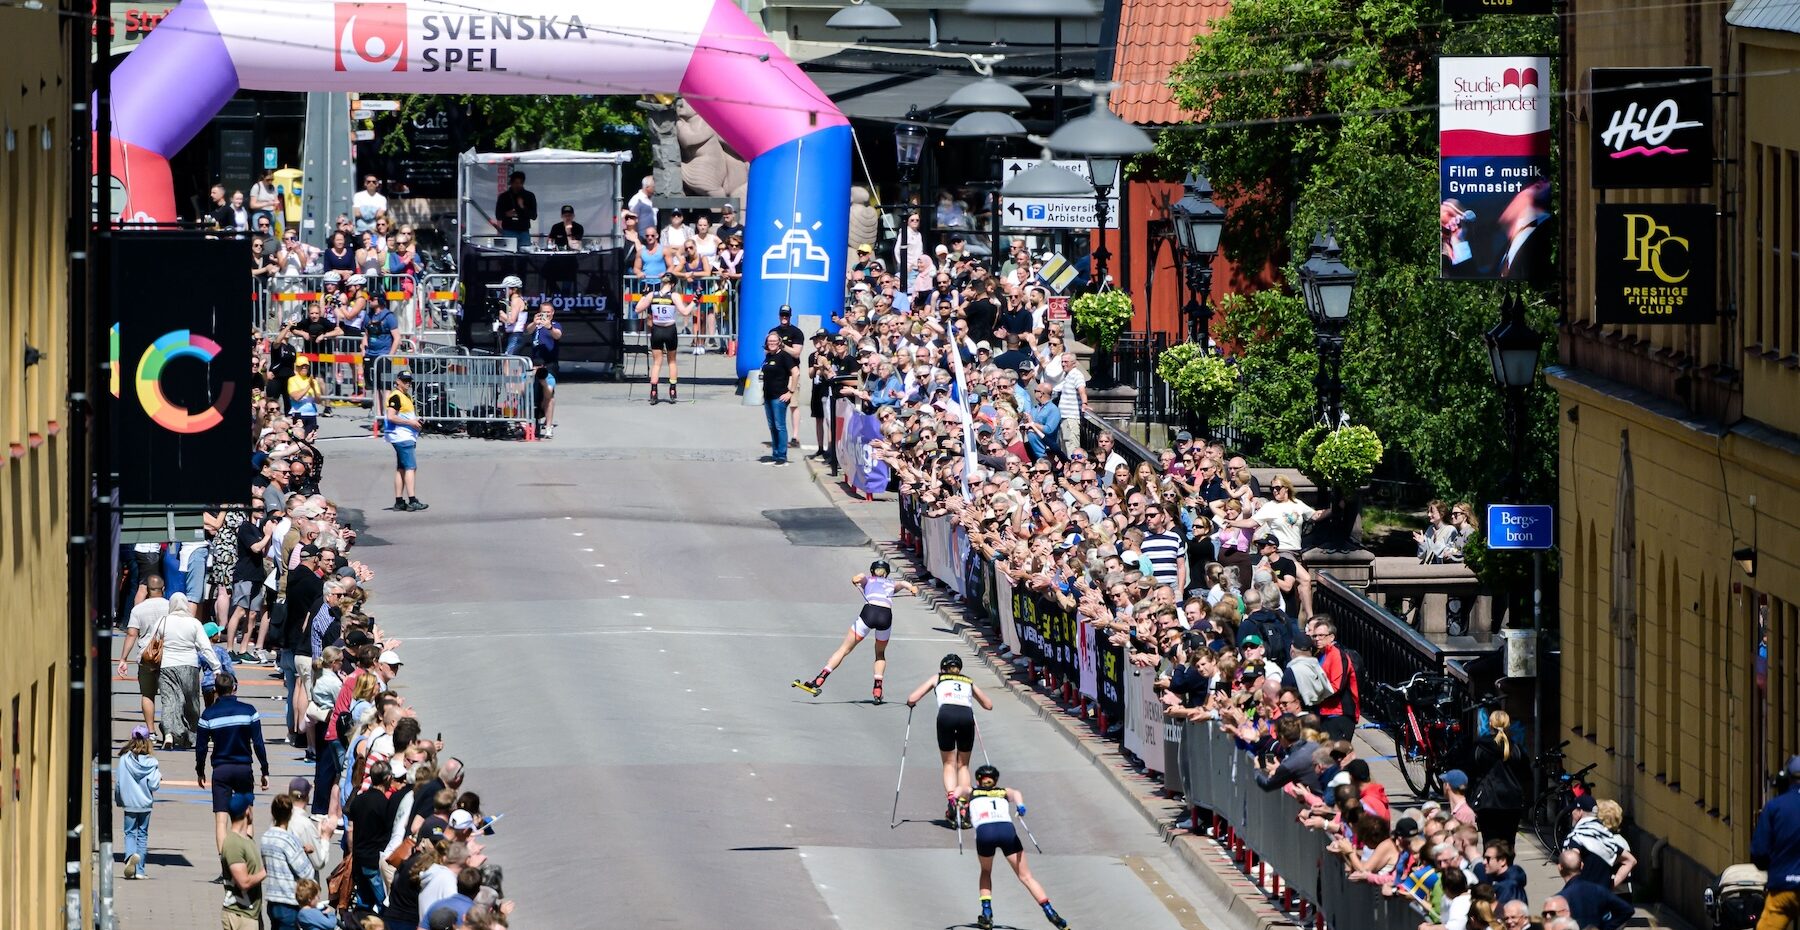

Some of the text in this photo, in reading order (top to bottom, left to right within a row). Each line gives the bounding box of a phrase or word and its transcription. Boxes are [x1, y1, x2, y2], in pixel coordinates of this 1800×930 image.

[124, 8, 173, 32] Str
[422, 14, 588, 41] SVENSKA
[422, 48, 507, 72] SPEL
[1453, 76, 1501, 93] Studie
[1454, 94, 1537, 117] främjandet
[1027, 162, 1082, 172] Pouset
[1449, 165, 1541, 177] Film & musik
[1449, 180, 1523, 194] Gymnasiet
[1047, 213, 1114, 223] Arbisteatn
[1623, 287, 1689, 296] PRESTIGE
[1628, 296, 1684, 305] FITNESS
[656, 306, 667, 315] 16
[1639, 305, 1673, 314] CLUB
[1501, 511, 1539, 529] Bergs-
[1506, 527, 1533, 542] bron
[953, 682, 962, 692] 3
[989, 799, 997, 810] 1
